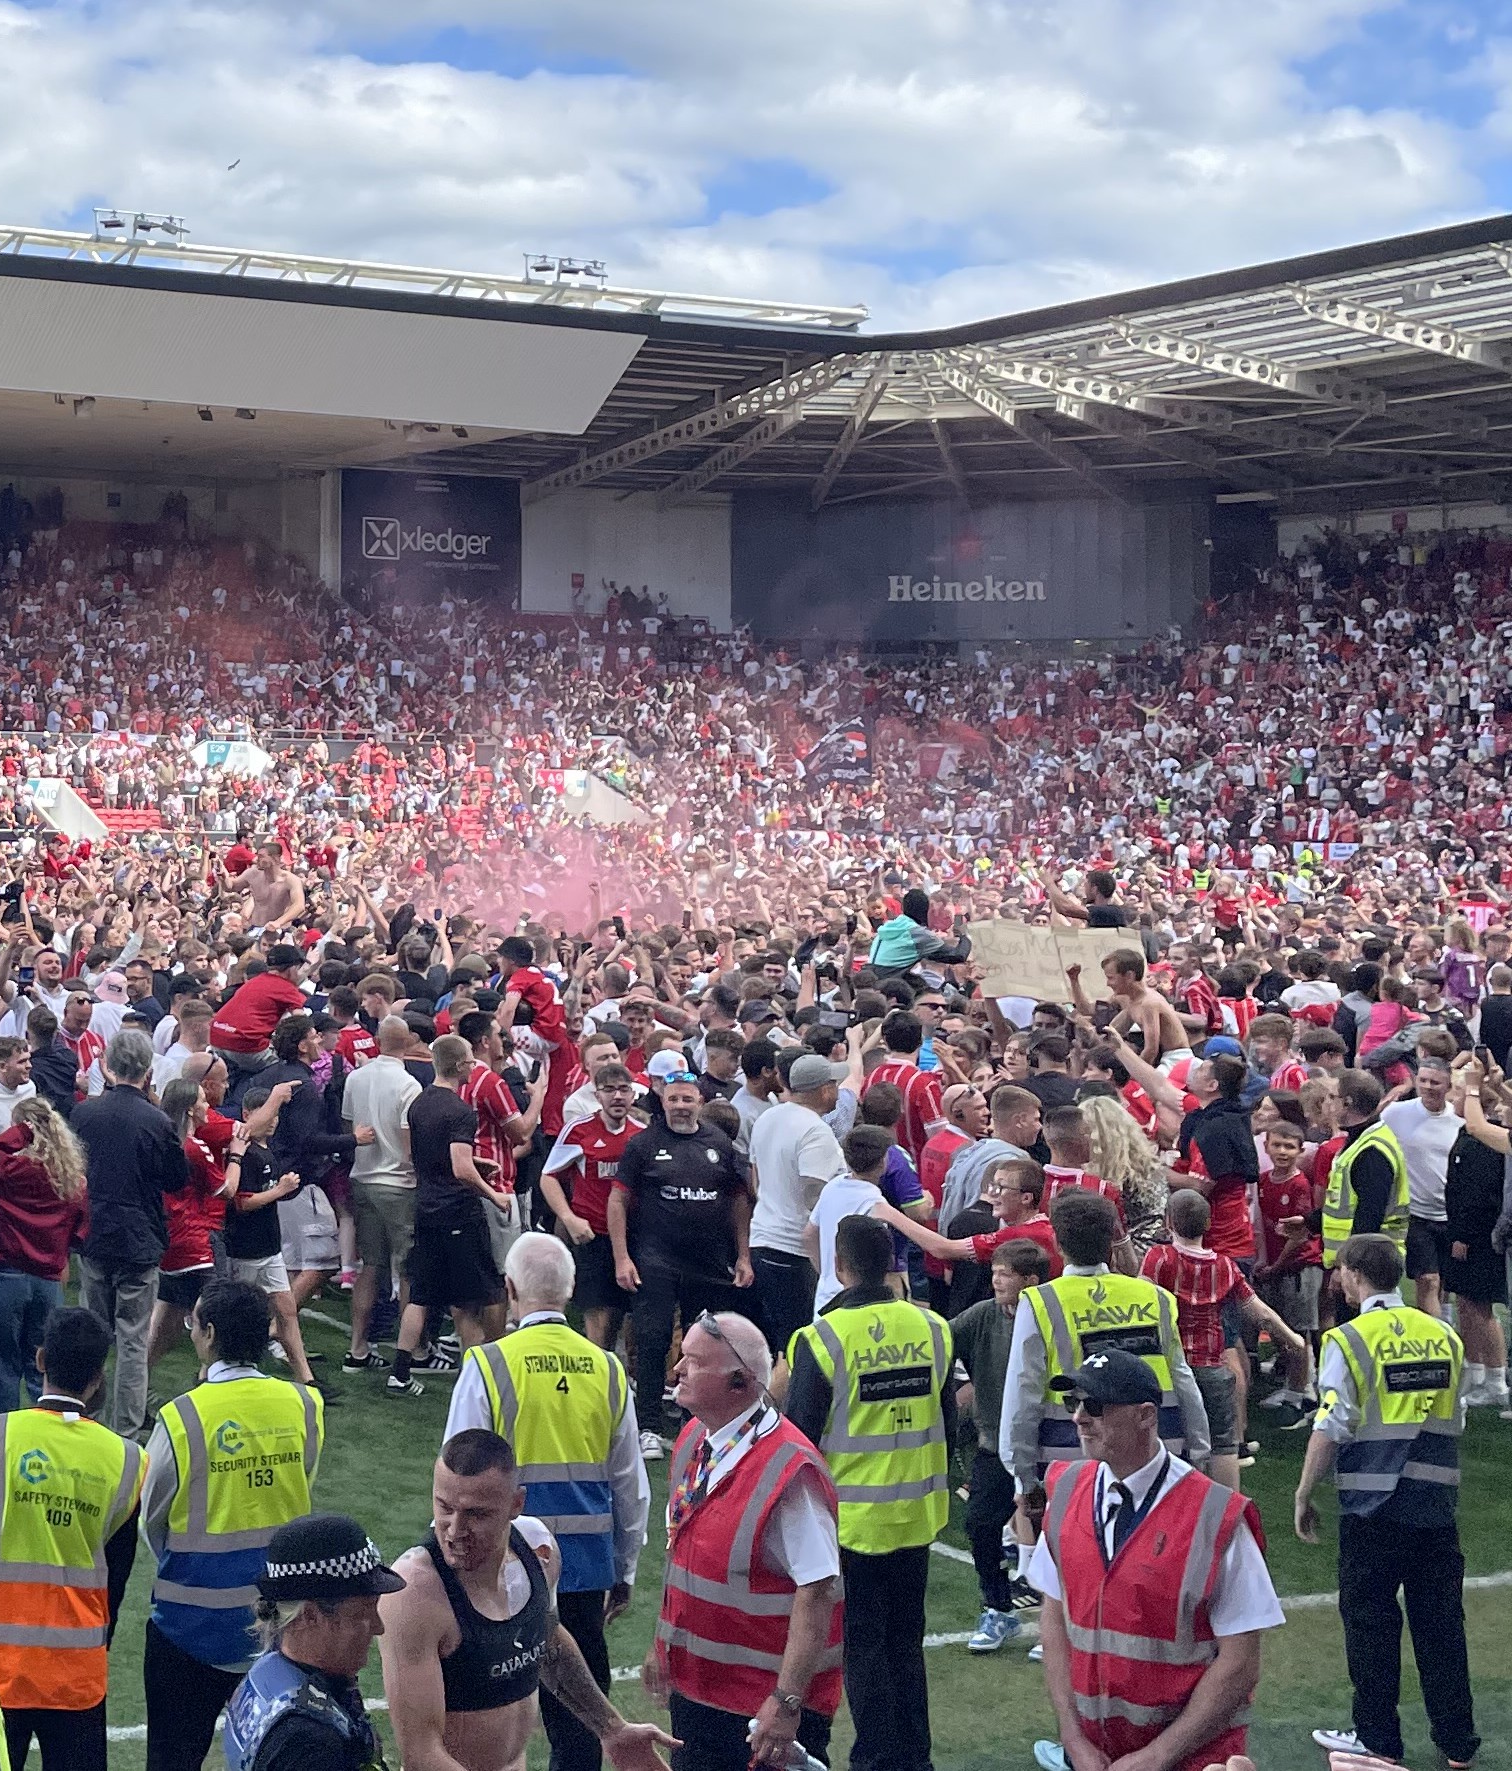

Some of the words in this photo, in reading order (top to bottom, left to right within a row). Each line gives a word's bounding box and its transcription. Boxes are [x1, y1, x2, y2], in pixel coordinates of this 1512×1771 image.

[401, 525, 491, 560] xledger
[888, 574, 1047, 601] Heineken
[1466, 964, 1477, 988] 1
[1072, 1302, 1159, 1330] HAWK
[854, 1340, 932, 1370] HAWK
[1375, 1338, 1450, 1361] HAWK
[555, 1375, 570, 1394] 4
[210, 1456, 258, 1473] SECURITY
[260, 1451, 302, 1467] STEWAR
[246, 1468, 274, 1489] 153
[14, 1490, 53, 1506] SAFETY
